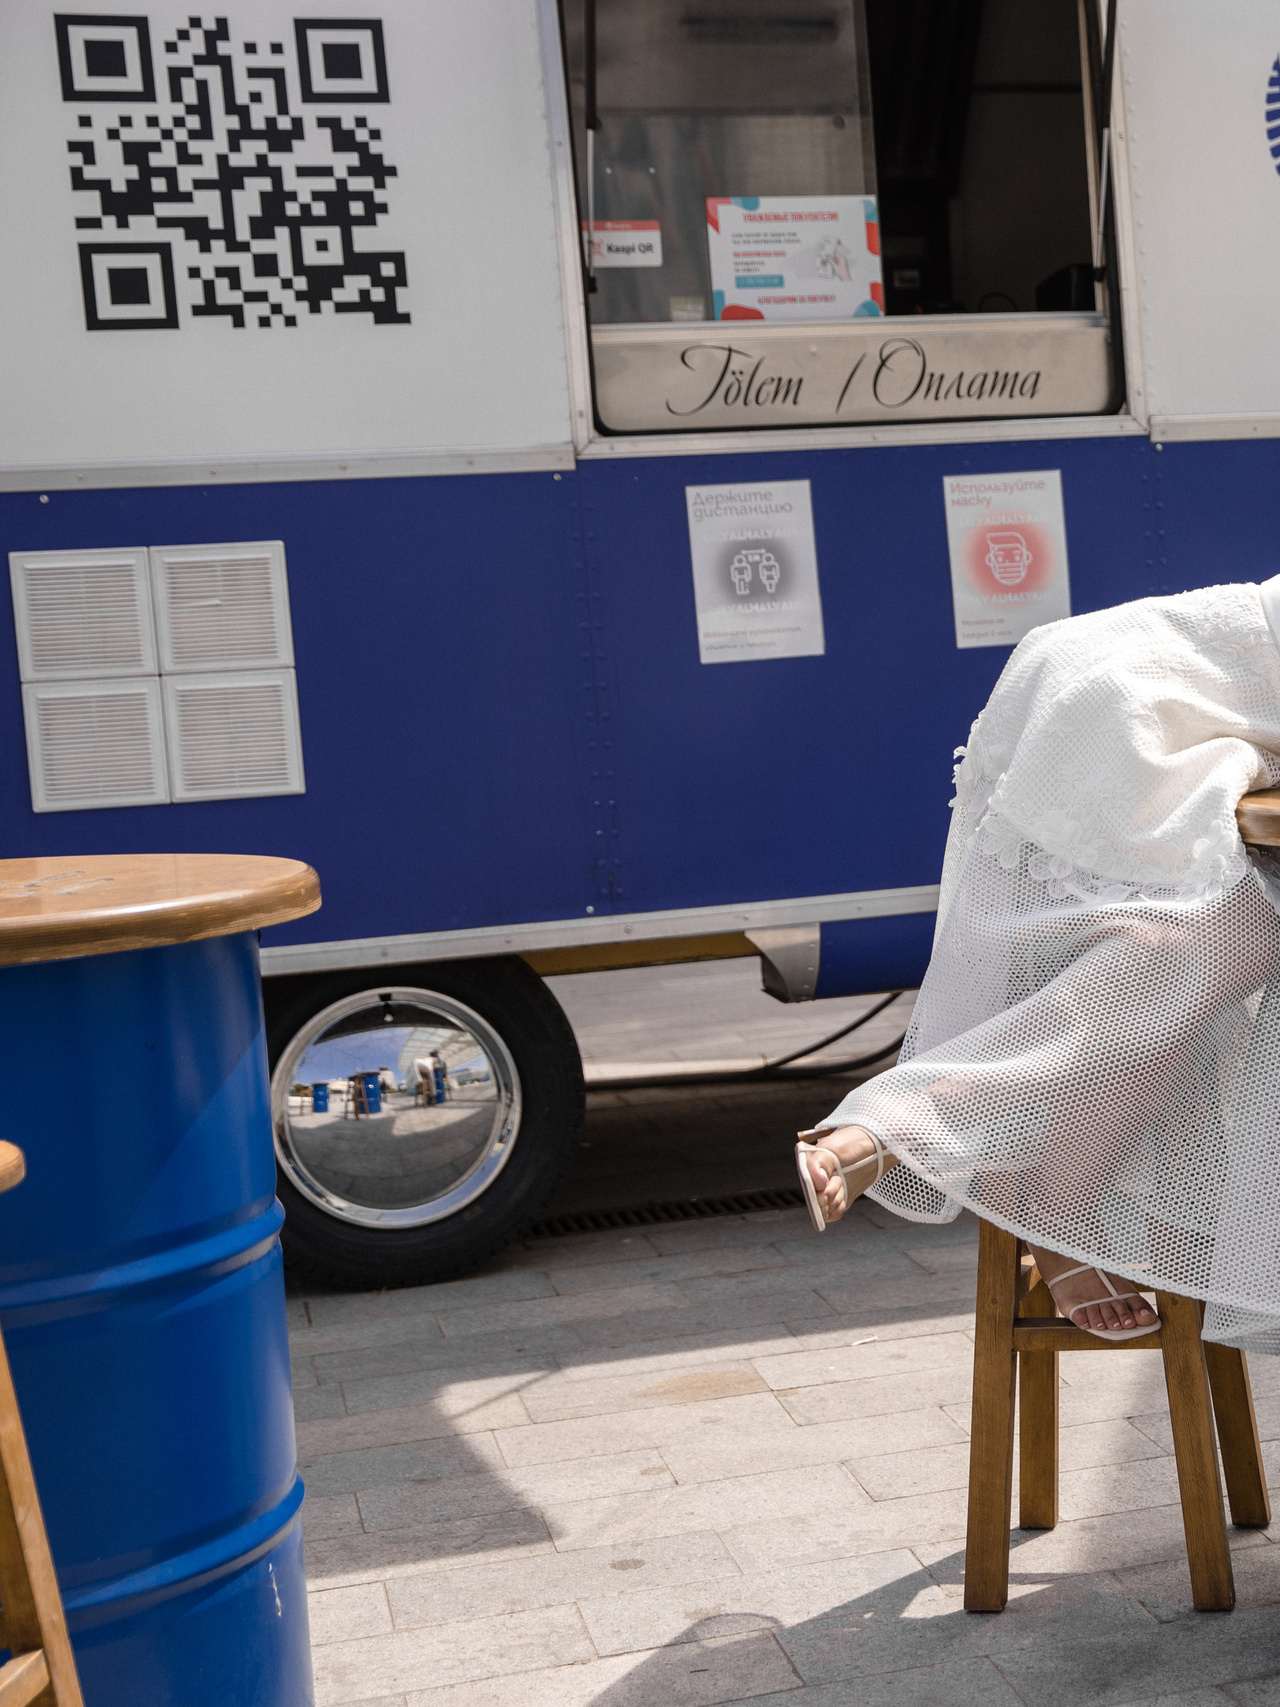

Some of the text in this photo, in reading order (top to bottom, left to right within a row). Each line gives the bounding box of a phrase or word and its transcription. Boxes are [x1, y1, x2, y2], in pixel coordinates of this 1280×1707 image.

[790, 211, 839, 222] ПОКУПАТЕЛИ
[606, 242, 654, 256] Kaspi QR
[666, 344, 804, 416] Tölem
[873, 337, 1041, 409] Оплата
[951, 479, 1045, 495] Используйте
[693, 490, 773, 506] Держите
[951, 494, 993, 508] маску
[693, 502, 793, 522] дистанцию
